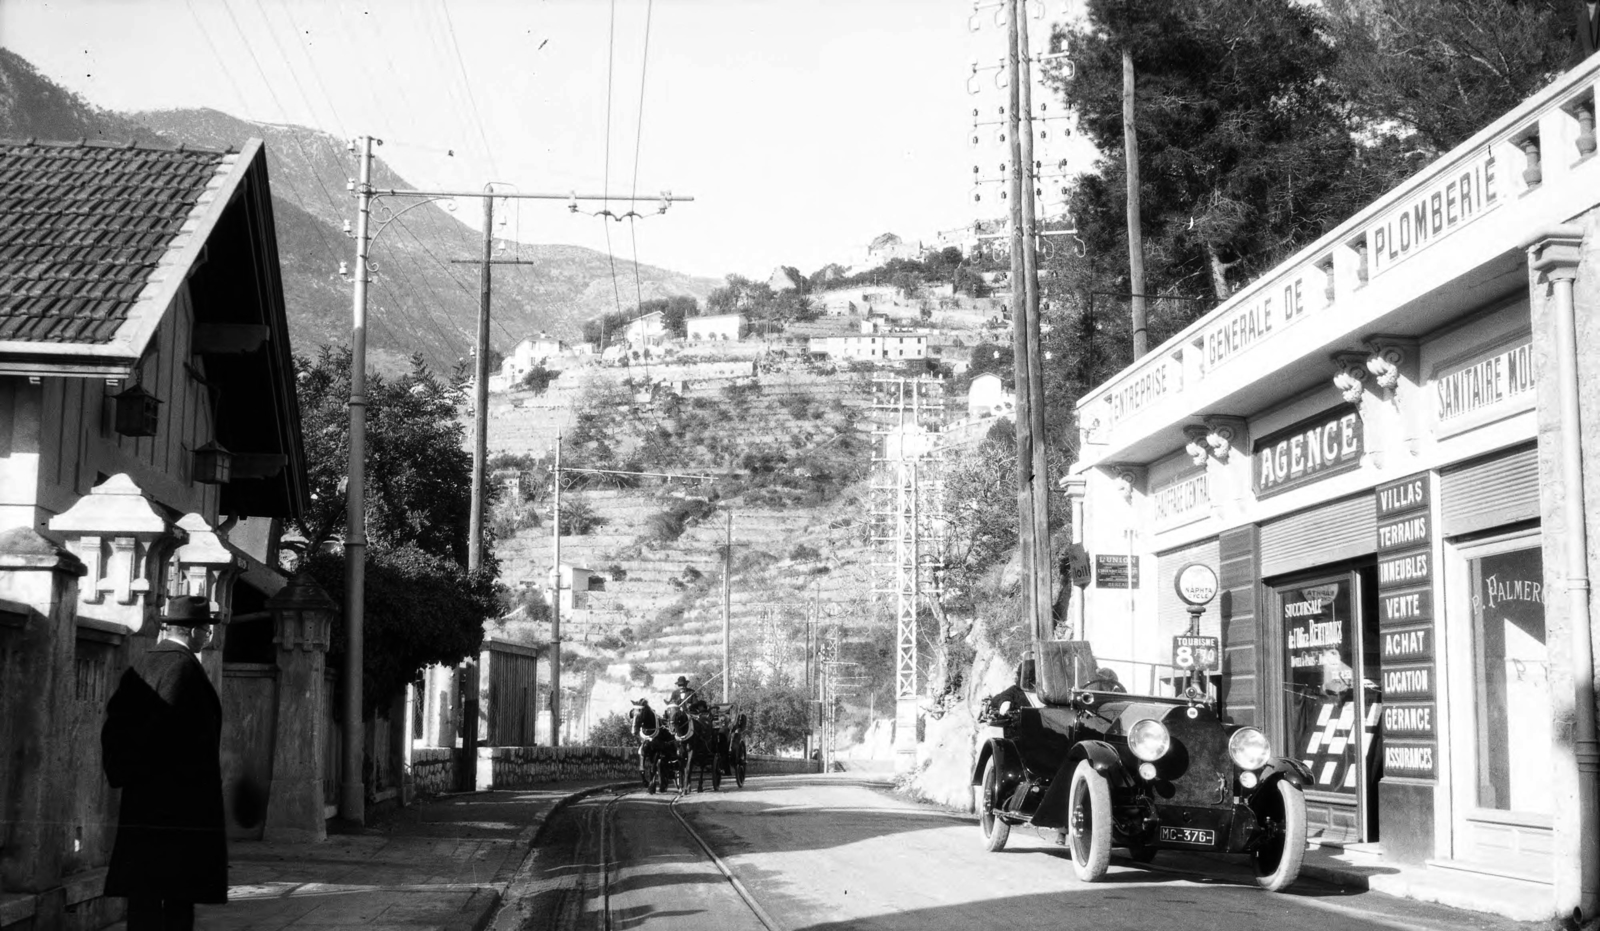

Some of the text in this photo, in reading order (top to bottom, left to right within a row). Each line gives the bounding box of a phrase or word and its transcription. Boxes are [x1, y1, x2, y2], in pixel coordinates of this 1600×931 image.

[1114, 156, 1497, 420] ENTREPRISE GENERALE DE PLOMBERIE
[1438, 356, 1503, 420] SANITAIRE
[1260, 412, 1358, 489] AGENCE
[1380, 481, 1423, 512] VILLAS
[1379, 517, 1426, 548] TERRAINS
[1380, 554, 1428, 583] IMMEUBLES
[1385, 594, 1420, 619] VENTE
[1177, 637, 1216, 646] TOURISME
[1385, 631, 1425, 655] ACHAT
[1384, 669, 1428, 693] LOCATION
[1385, 705, 1431, 730] GÉRANCE
[1385, 747, 1433, 769] ASSURANCES
